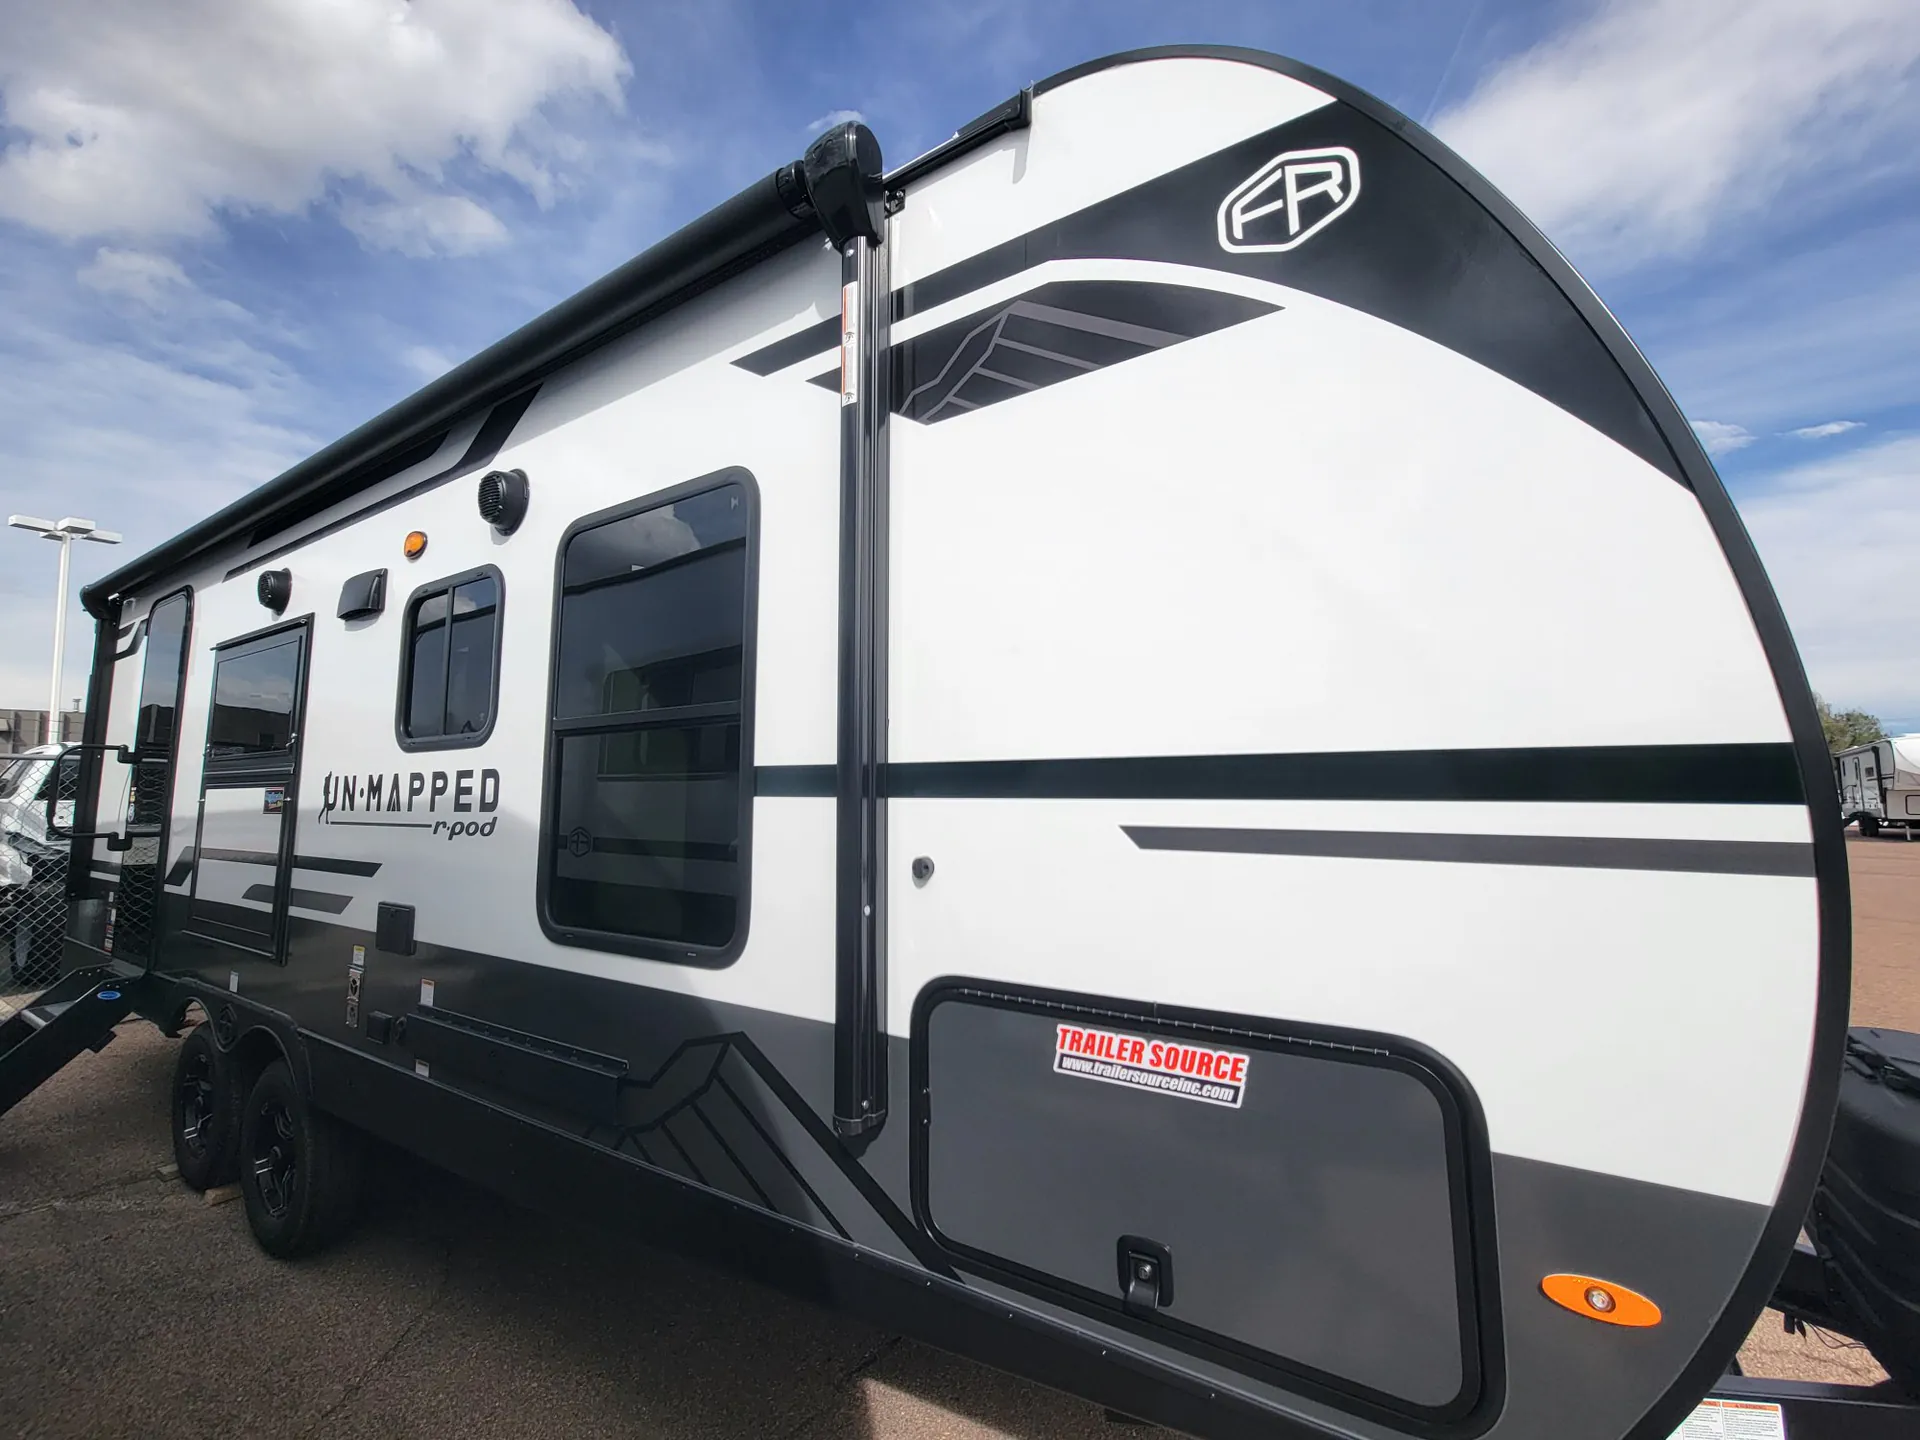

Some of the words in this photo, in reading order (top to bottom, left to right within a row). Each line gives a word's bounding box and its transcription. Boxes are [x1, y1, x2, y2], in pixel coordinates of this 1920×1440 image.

[1059, 1028, 1145, 1064] TRAILER
[1149, 1044, 1246, 1082] SOURCE
[1062, 1057, 1235, 1101] www.trailersourceinc.com
